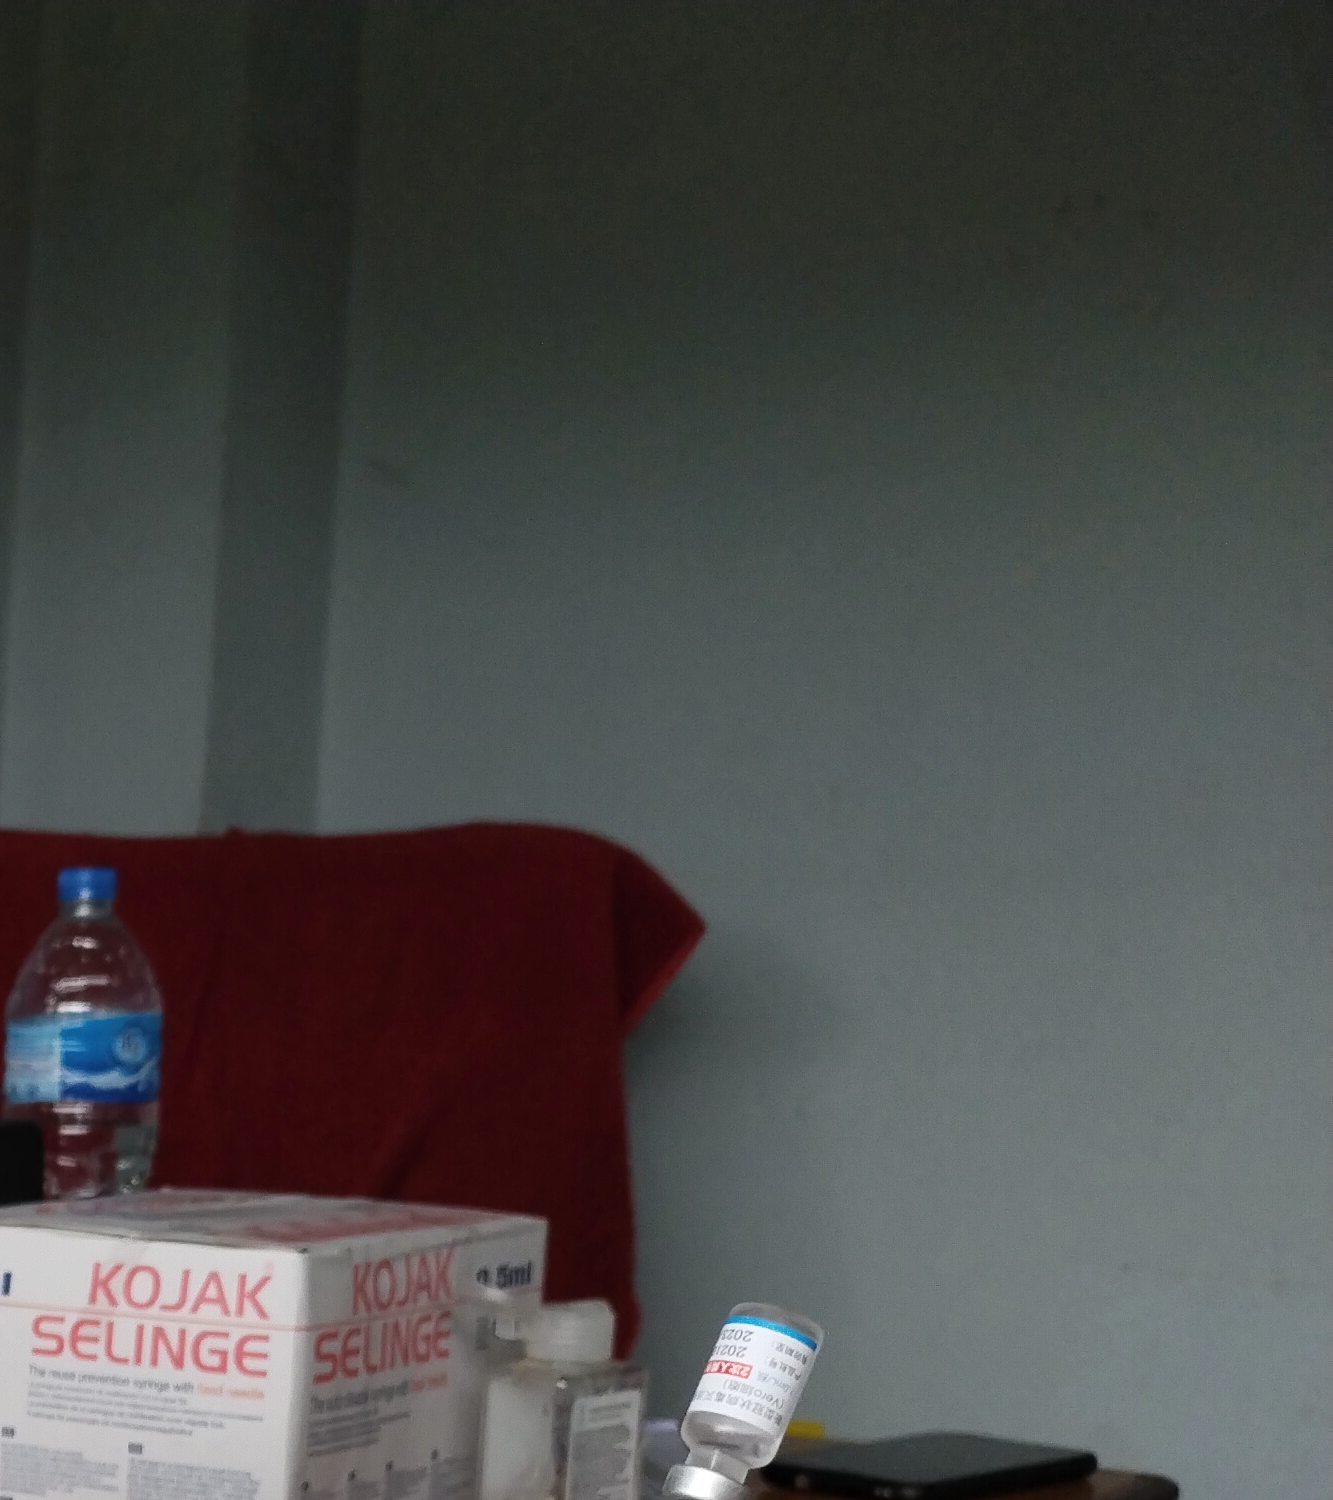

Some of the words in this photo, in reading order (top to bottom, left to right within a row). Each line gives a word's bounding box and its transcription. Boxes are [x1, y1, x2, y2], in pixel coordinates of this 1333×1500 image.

[87, 1262, 272, 1320] KOJAK
[352, 1246, 454, 1316] KOJAK
[31, 1314, 270, 1378] SELINGE
[313, 1311, 451, 1385] SELINGE
[173, 1381, 194, 1393] with
